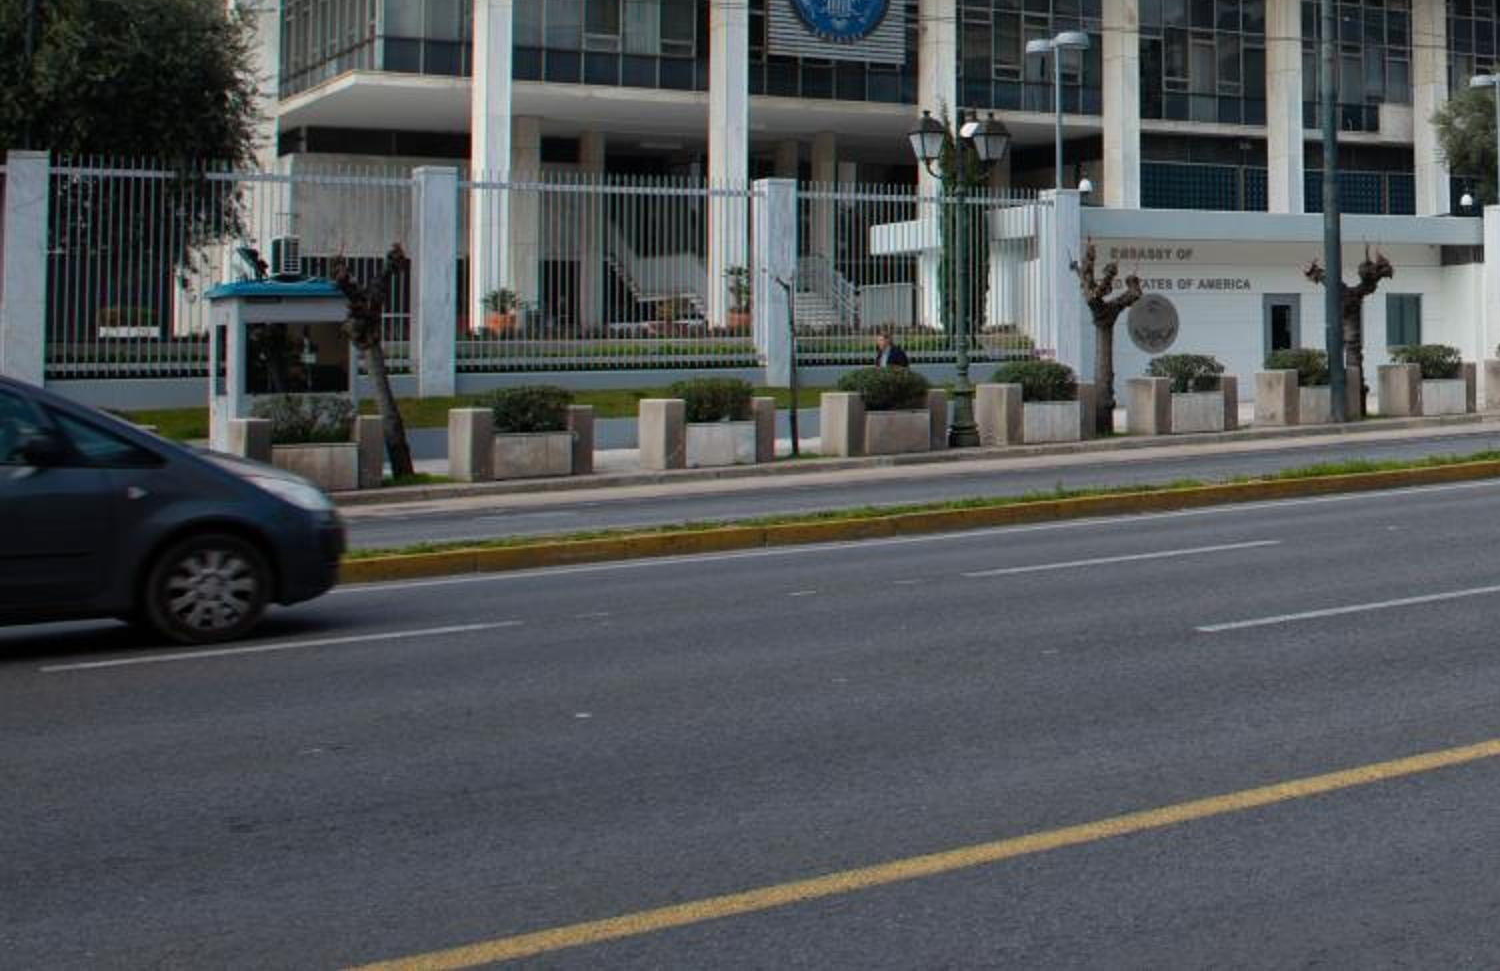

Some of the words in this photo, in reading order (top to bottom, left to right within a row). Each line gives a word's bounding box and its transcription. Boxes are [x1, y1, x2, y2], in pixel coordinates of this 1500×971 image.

[1110, 247, 1172, 260] EMBASSY
[1176, 247, 1194, 260] OF
[1177, 278, 1193, 290] OF
[1197, 278, 1251, 290] AMERICA
